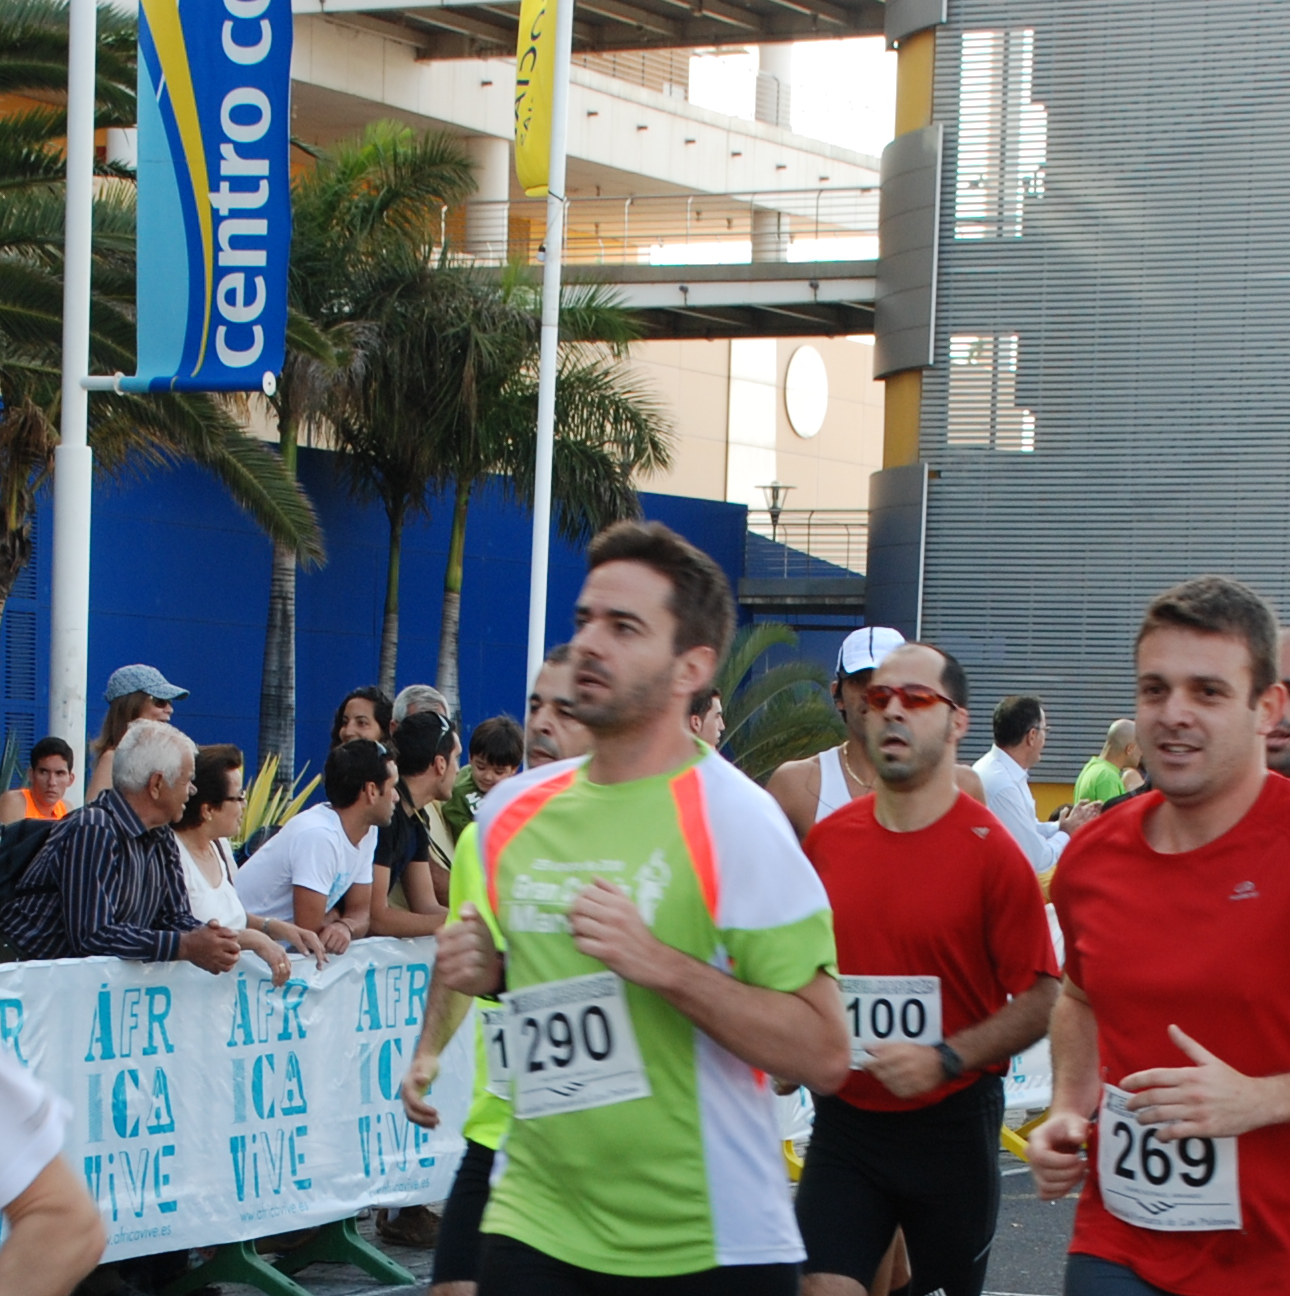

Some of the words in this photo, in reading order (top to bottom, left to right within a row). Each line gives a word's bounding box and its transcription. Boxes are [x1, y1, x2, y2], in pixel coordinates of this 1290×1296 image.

[215, 87, 272, 368] centro
[521, 1005, 614, 1073] 290
[846, 998, 926, 1039] 100
[85, 1066, 175, 1144] ICA
[232, 1050, 308, 1124] ICA
[1112, 1120, 1216, 1188] 269
